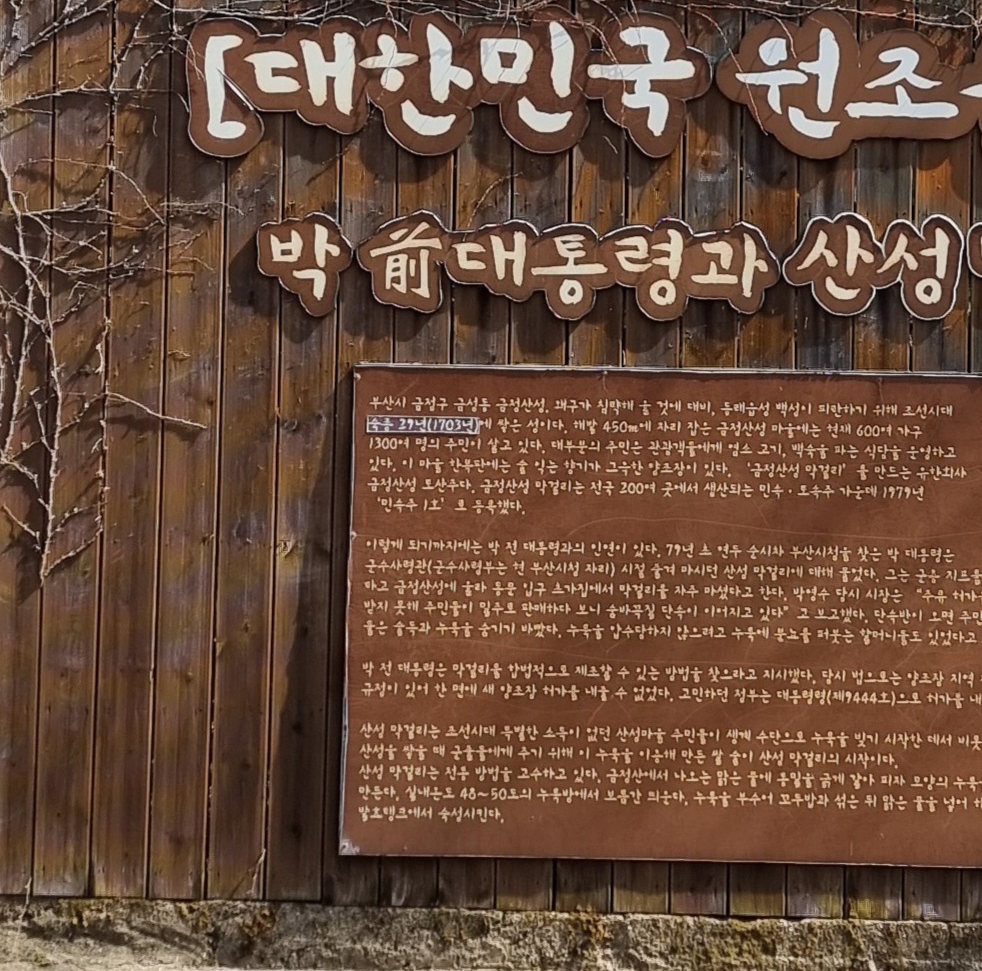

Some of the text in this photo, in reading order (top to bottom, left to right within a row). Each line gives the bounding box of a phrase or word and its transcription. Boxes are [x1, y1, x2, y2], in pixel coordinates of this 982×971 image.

[271, 224, 341, 301] 박
[797, 225, 950, 305] 산성
[369, 396, 953, 419] 부산시 금성동 것에 백성이 위해 조선시대
[657, 420, 922, 439] 자리 잡은 금정산성 마을에는 현재 600여 가구
[369, 437, 957, 461] 1300여 명의 주민이 대부분의 주민은 관광객들에게 백숙을 파는 식당을 운영하고
[419, 458, 967, 481] 마을 양조장이 만드는 유한회사
[367, 477, 924, 501] 금정산성 금정산성 막걸리는 전국 200여 곳에서 민속 가운데 1979년
[367, 538, 955, 563] 이렇게 되기까지에는 박 전 대통령과의 인연이 79년 연두 부산시청을 찾은 박 대통령은
[513, 561, 525, 576] 현
[530, 561, 580, 577] 부산시청
[585, 562, 616, 578] 자리)
[621, 563, 645, 579] 시절
[681, 564, 718, 579] 마시던
[723, 564, 748, 580] 산성
[753, 565, 803, 582] 막걸리에
[809, 566, 834, 579] 대해
[885, 568, 910, 583] 그는
[946, 569, 982, 586] 지프를
[394, 579, 457, 595] 금정산성에
[523, 581, 547, 598] 입구
[619, 583, 669, 600] 막걸리를
[675, 585, 699, 598] 자주
[793, 586, 830, 602] 박영수
[836, 587, 860, 603] 당시
[866, 588, 903, 604] 시장은
[393, 600, 419, 616] 못해
[424, 600, 473, 617] 주민들이
[522, 602, 571, 618] 판매하다
[576, 603, 600, 616] 보니
[662, 604, 698, 621] 단속이
[705, 605, 754, 618] 이어지고
[874, 608, 922, 625] 단속반이
[929, 609, 954, 625] 오면
[478, 622, 516, 637] 숨기기
[611, 623, 671, 640] 압수당하지
[731, 626, 769, 642] 누룩에
[859, 628, 922, 646] 할머니들도
[929, 630, 978, 646] 있었다고
[363, 661, 374, 678] 박
[379, 661, 392, 677] 전
[398, 662, 448, 678] 대통령은
[453, 662, 503, 679] 막걸리를
[575, 664, 612, 682] 제조할
[637, 665, 660, 682] 있는
[665, 666, 703, 683] 방법을
[708, 666, 758, 683] 찾으라고
[822, 668, 846, 685] 당시
[852, 669, 902, 686] 법으로는
[907, 671, 944, 687] 양조장
[950, 672, 974, 688] 지역
[361, 682, 398, 698] 규정이
[405, 682, 428, 698] 있어
[453, 683, 477, 699] 면에
[501, 683, 537, 700] 양조장
[543, 685, 580, 701] 허가를
[679, 687, 728, 703] 고민하던
[734, 688, 772, 704] 정부는
[927, 692, 965, 709] 허가를
[360, 723, 385, 739] 산성
[391, 723, 441, 740] 막걸리는
[445, 723, 496, 740] 조선시대
[543, 726, 580, 742] 소득이
[587, 726, 610, 742] 없던
[616, 727, 666, 745] 산성마을
[671, 728, 720, 745] 주민들이
[726, 729, 751, 745] 생계
[756, 730, 806, 746] 수단으로
[885, 732, 923, 750] 시작한
[927, 734, 952, 747] 데서
[360, 743, 398, 761] 산성을
[518, 746, 542, 760] 주기
[548, 747, 573, 760] 위해
[640, 748, 676, 764] 이용해
[681, 748, 706, 765] 만든
[729, 750, 753, 767] 술이
[759, 750, 784, 767] 산성
[789, 751, 839, 768] 막걸리의
[359, 764, 384, 780] 산성
[389, 764, 440, 781] 막걸리는
[475, 766, 513, 783] 방법을
[517, 767, 567, 782] 고수하고
[606, 768, 668, 784] 금정산에서
[674, 770, 712, 785] 나오는
[881, 774, 906, 787] 피자
[911, 774, 948, 791] 모양의
[405, 785, 455, 802] 실내온도
[537, 787, 599, 804] 누룩방에서
